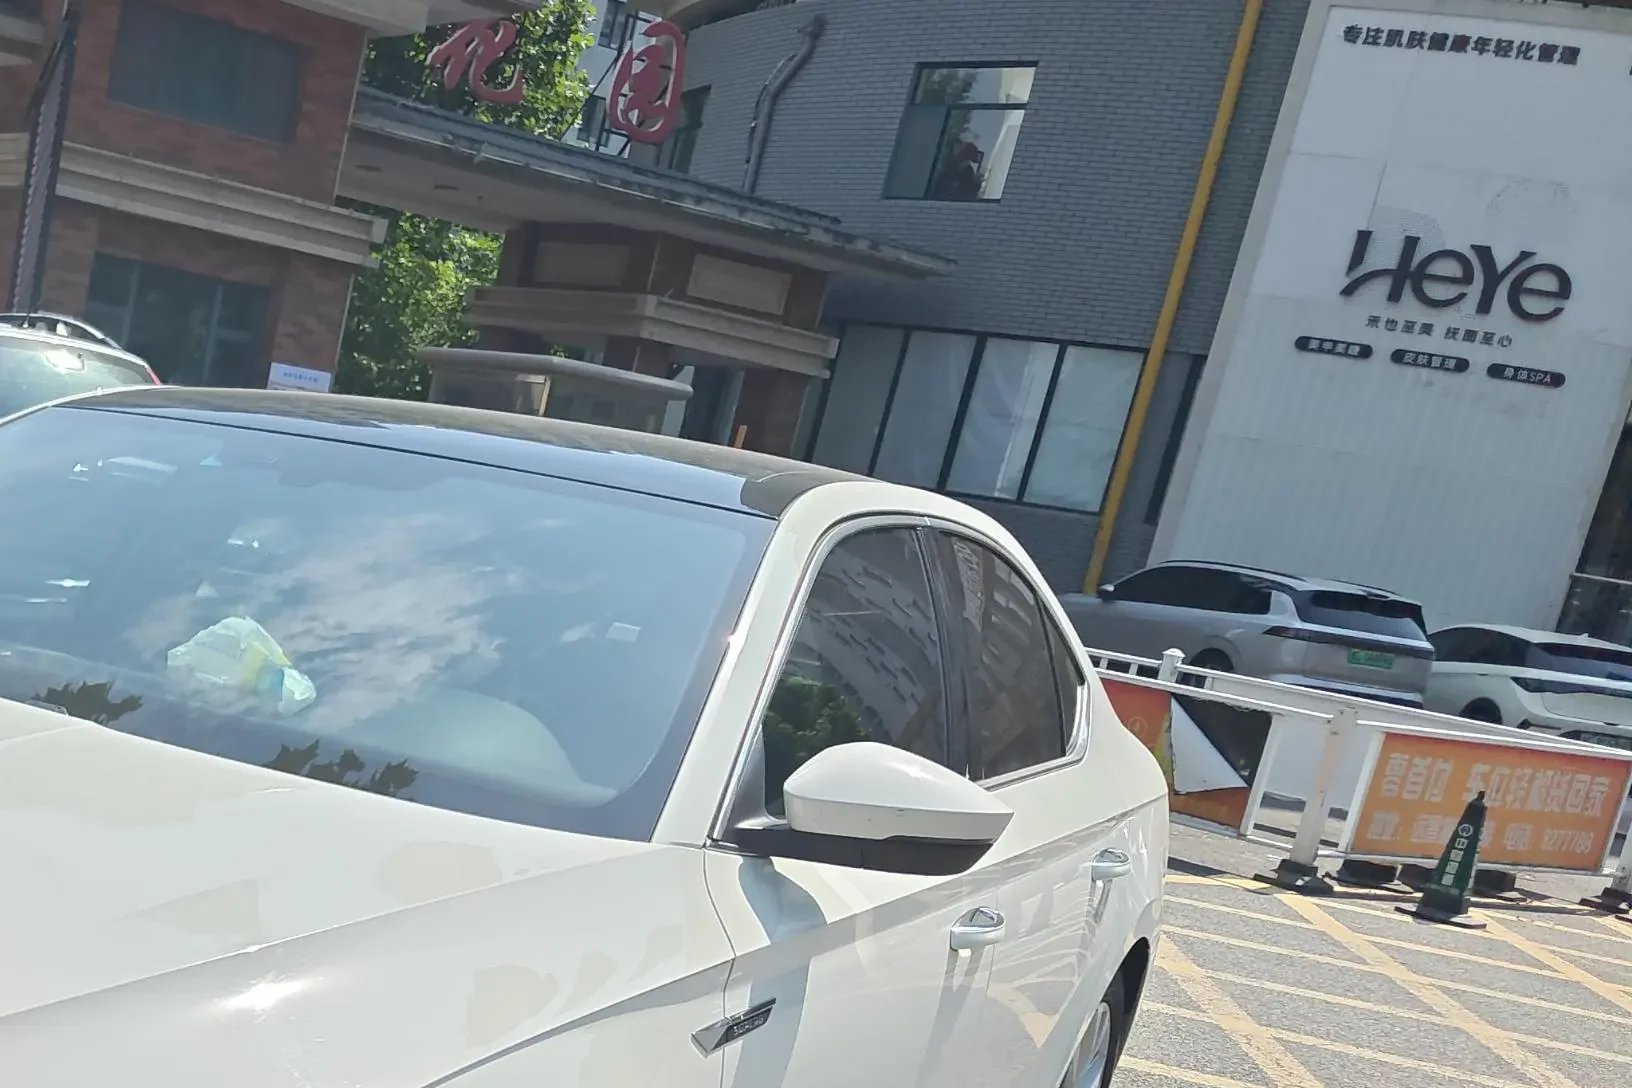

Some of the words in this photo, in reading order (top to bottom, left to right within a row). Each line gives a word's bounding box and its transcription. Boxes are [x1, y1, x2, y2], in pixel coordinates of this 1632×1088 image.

[1342, 23, 1581, 66] 专注肌肤健康年轻化管理
[1338, 229, 1573, 323] HeYe
[1401, 352, 1457, 371] 皮肤管理
